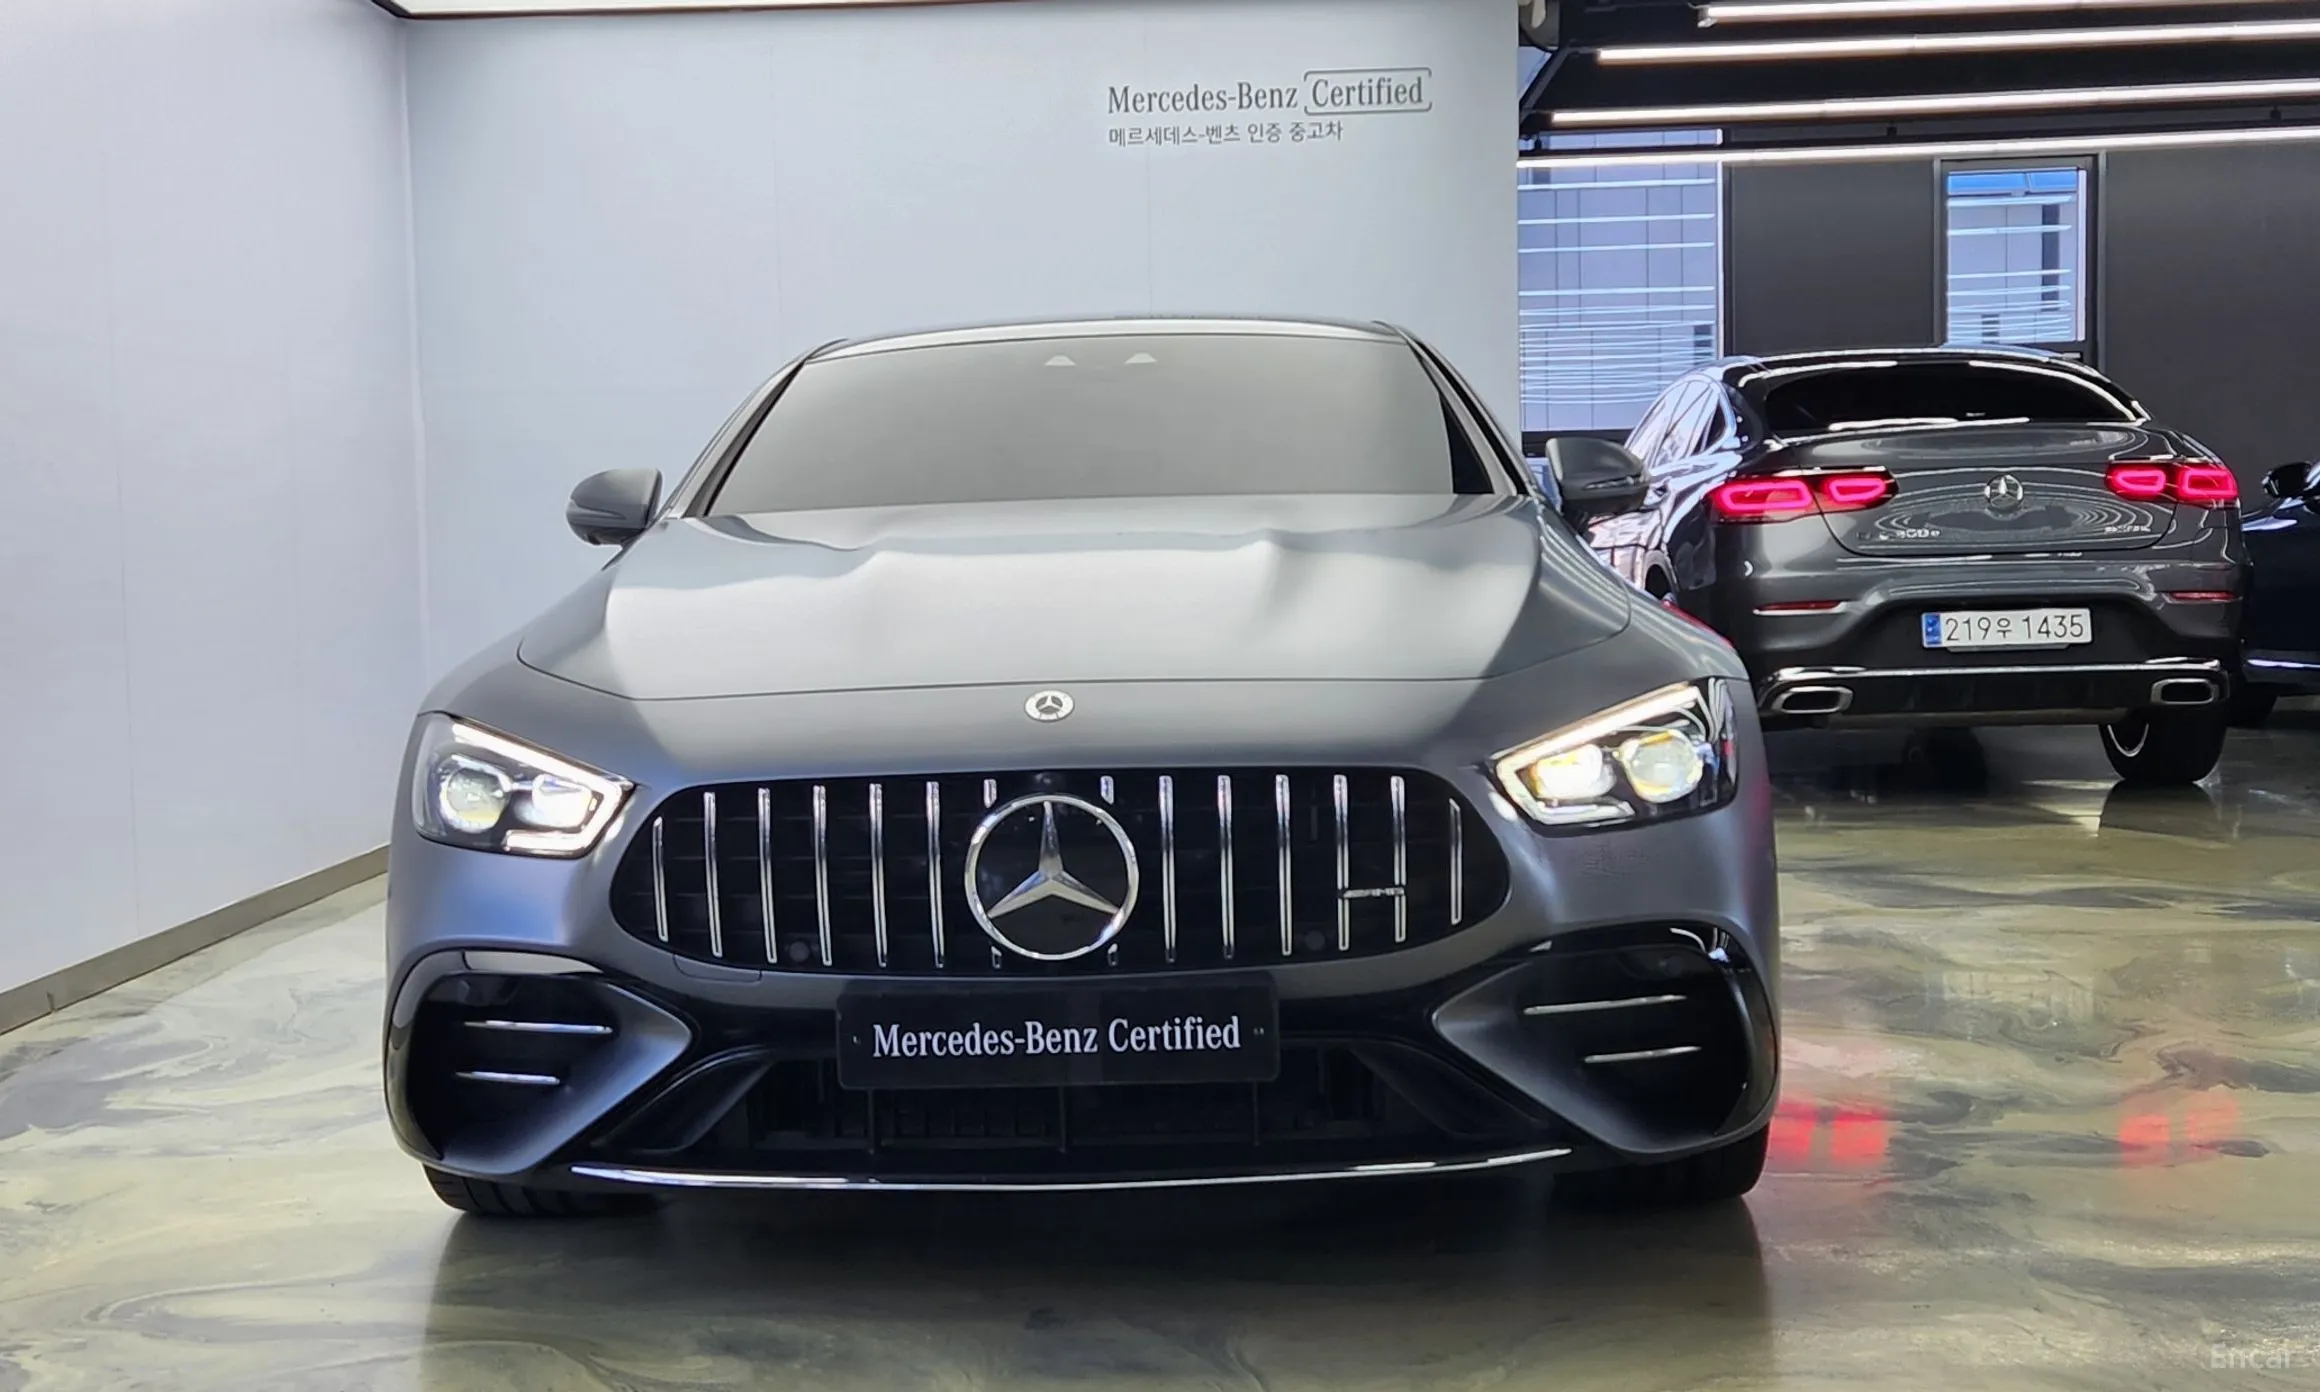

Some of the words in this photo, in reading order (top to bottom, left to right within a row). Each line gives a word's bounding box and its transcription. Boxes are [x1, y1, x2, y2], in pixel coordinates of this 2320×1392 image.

[1107, 81, 1299, 114] Mercedes-Benz
[1311, 76, 1424, 108] Certified
[1108, 124, 1241, 147] 메르세데스-벤츠
[1248, 123, 1283, 144] 인증
[1288, 120, 1344, 143] 중고차
[1945, 616, 2013, 641] 219우
[2022, 613, 2084, 640] 1435
[872, 1020, 1099, 1058] Mercedes-Benz
[1107, 1015, 1242, 1053] Certified
